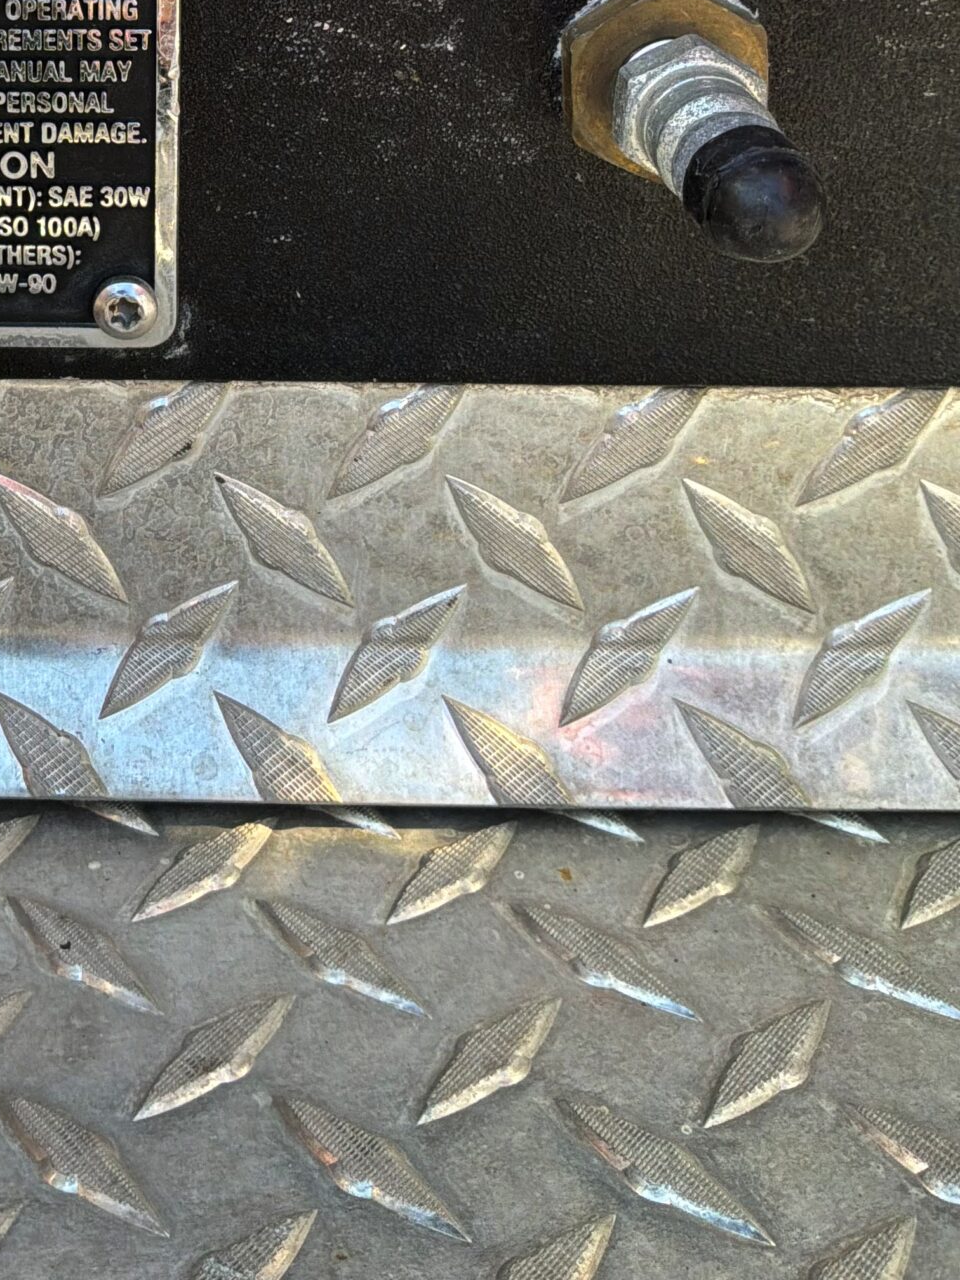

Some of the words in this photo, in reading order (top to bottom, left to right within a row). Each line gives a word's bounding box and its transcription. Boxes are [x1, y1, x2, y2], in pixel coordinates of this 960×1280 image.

[108, 29, 152, 51] SET
[79, 60, 132, 82] MAY
[41, 121, 147, 143] DAMAGE.
[48, 187, 94, 208] SAE
[100, 187, 150, 208] 30W
[37, 217, 100, 240] 100A)
